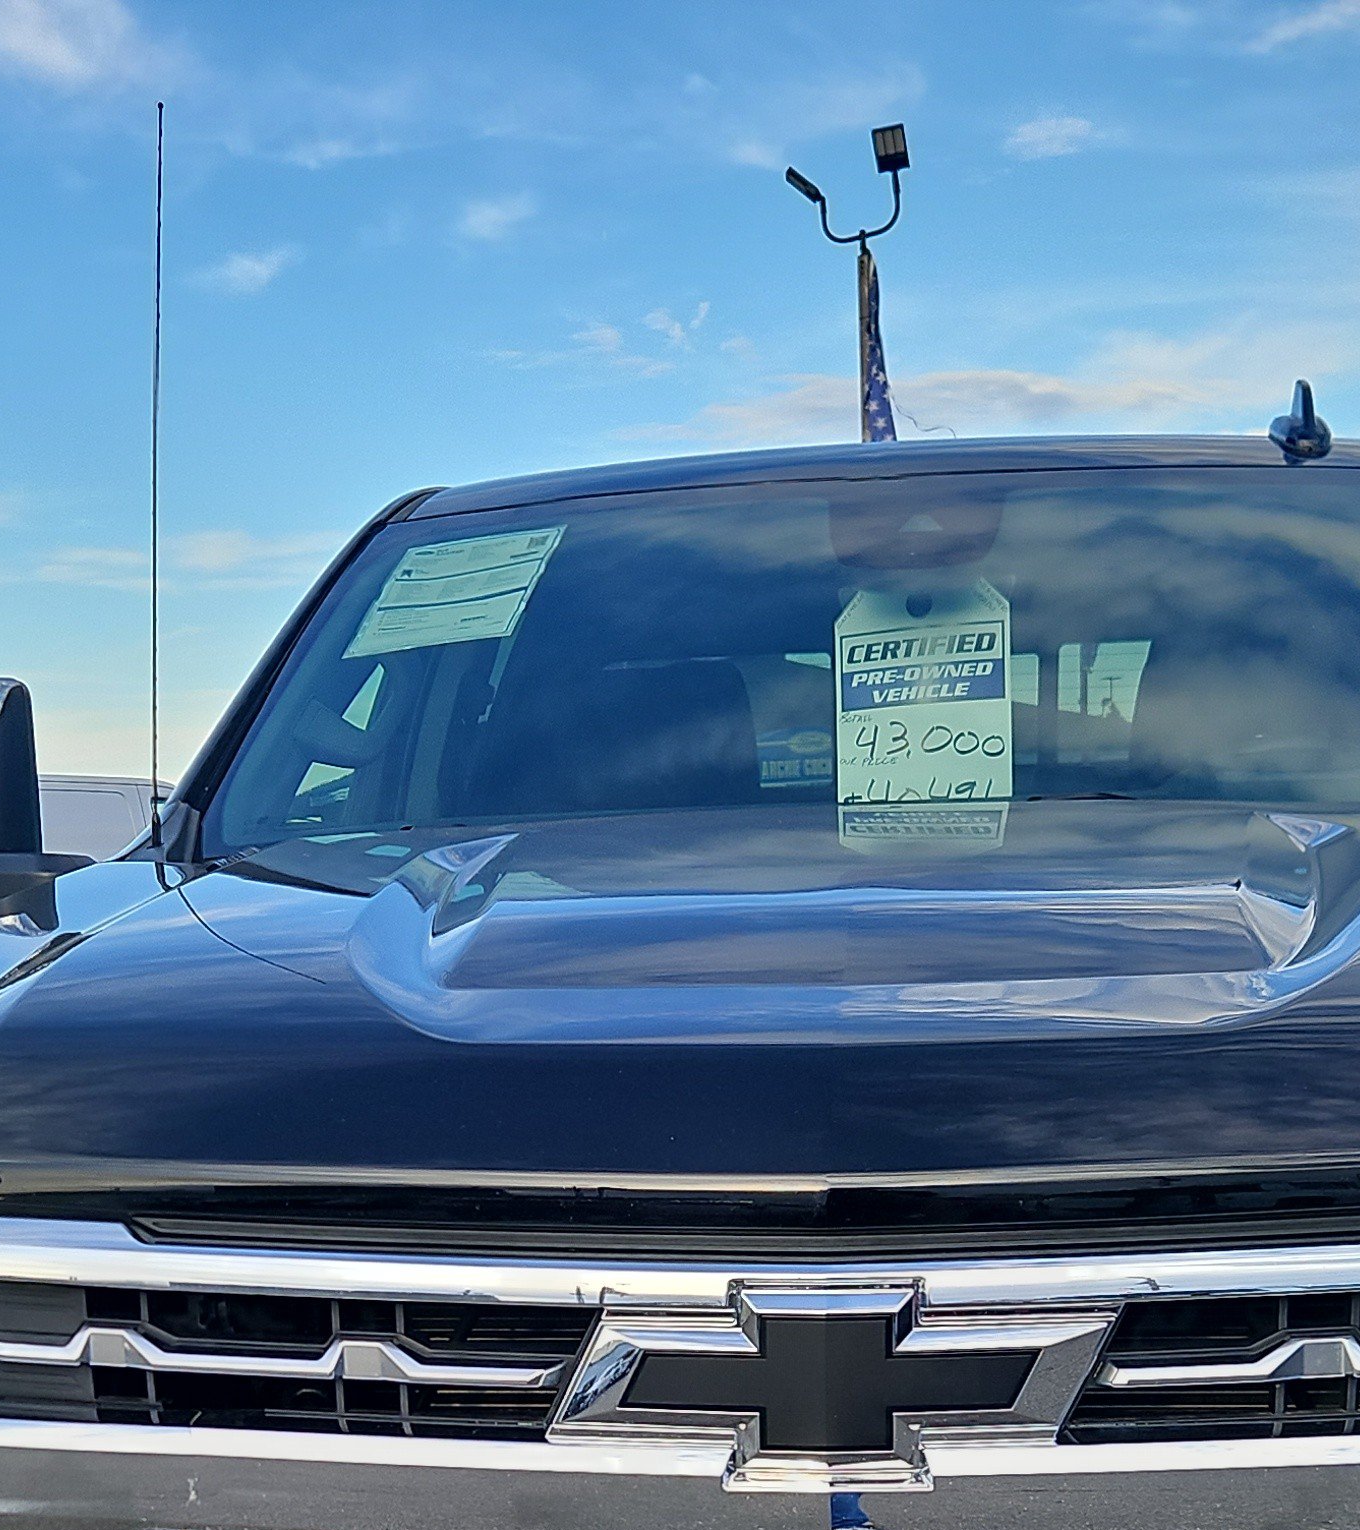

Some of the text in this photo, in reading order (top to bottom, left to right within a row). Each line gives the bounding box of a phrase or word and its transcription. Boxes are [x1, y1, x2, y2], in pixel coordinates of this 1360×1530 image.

[846, 632, 997, 665] CERTIFIED
[851, 662, 994, 688] PRE-OWNED
[872, 682, 971, 704] VEHICLE
[855, 721, 1005, 761] 43,000
